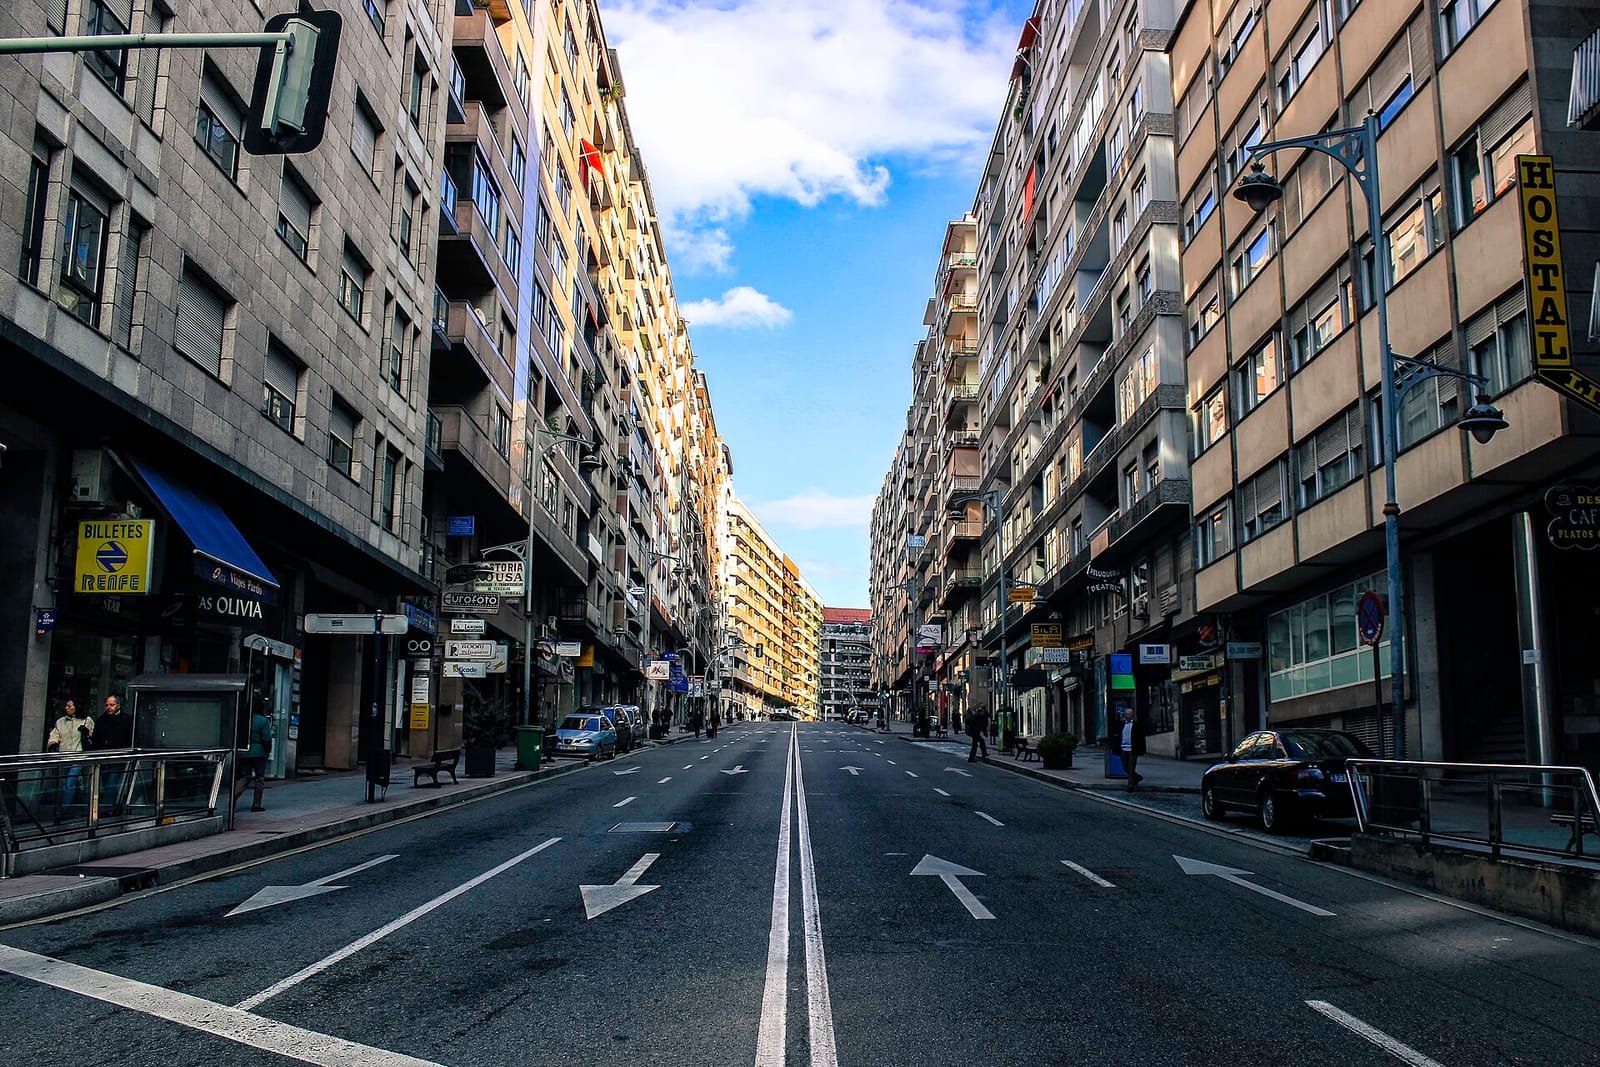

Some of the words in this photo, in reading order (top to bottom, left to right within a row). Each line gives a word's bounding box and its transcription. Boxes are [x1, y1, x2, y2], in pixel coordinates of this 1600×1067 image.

[1521, 161, 1568, 360] HOSTAL
[1564, 372, 1600, 405] LI
[84, 524, 143, 539] BILLETES
[1558, 529, 1594, 539] PLATOS
[489, 563, 523, 572] STORIA
[82, 574, 139, 591] RENFE
[198, 595, 213, 610] AS
[216, 596, 263, 619] OLIVIA
